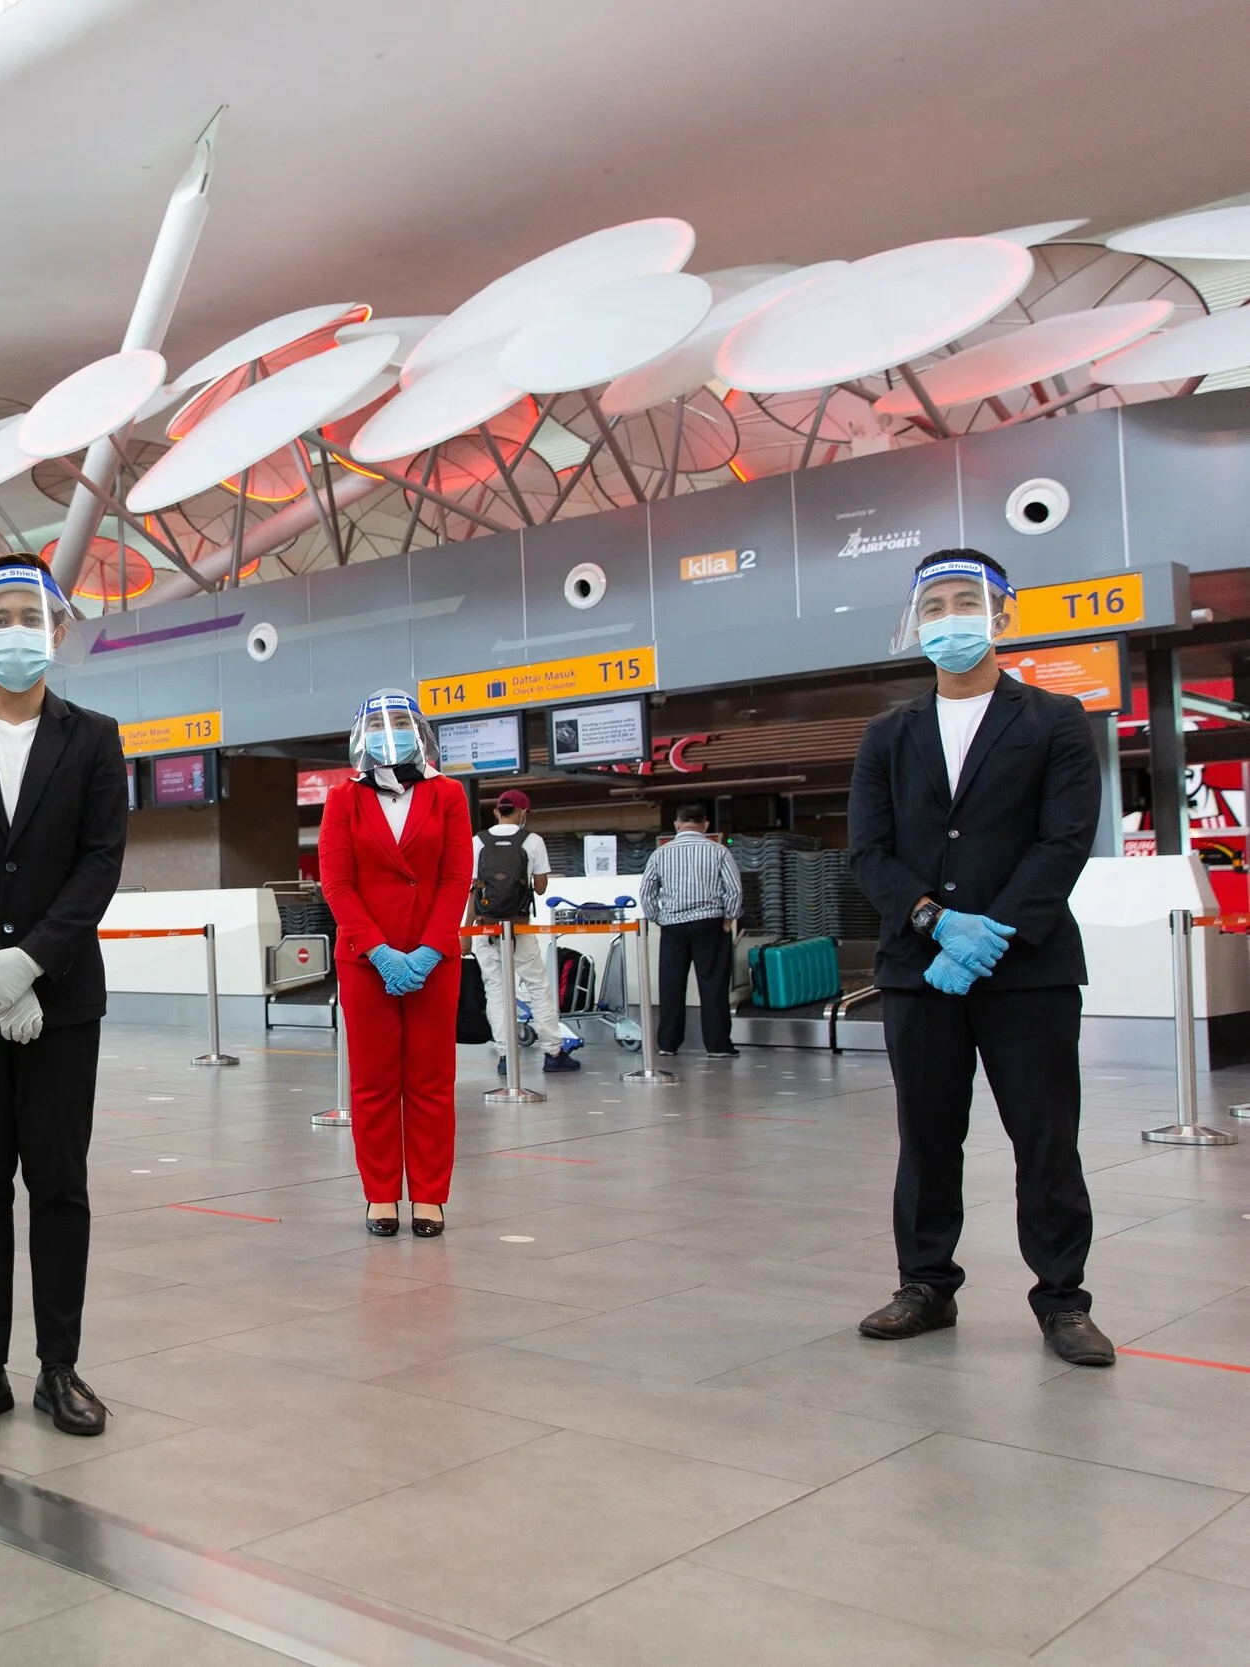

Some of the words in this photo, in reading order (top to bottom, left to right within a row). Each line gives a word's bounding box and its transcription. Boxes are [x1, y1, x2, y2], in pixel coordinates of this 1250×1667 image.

[859, 536, 921, 553] AIRPORTS
[862, 529, 921, 543] MALAYSIA
[688, 557, 729, 577] klia
[740, 550, 756, 569] 2
[925, 566, 945, 575] Face
[1062, 588, 1125, 618] T16
[512, 675, 541, 685] Daftar
[544, 669, 575, 680] Masuk
[598, 658, 641, 682] T15
[429, 684, 466, 706] T14
[185, 720, 212, 738] T13
